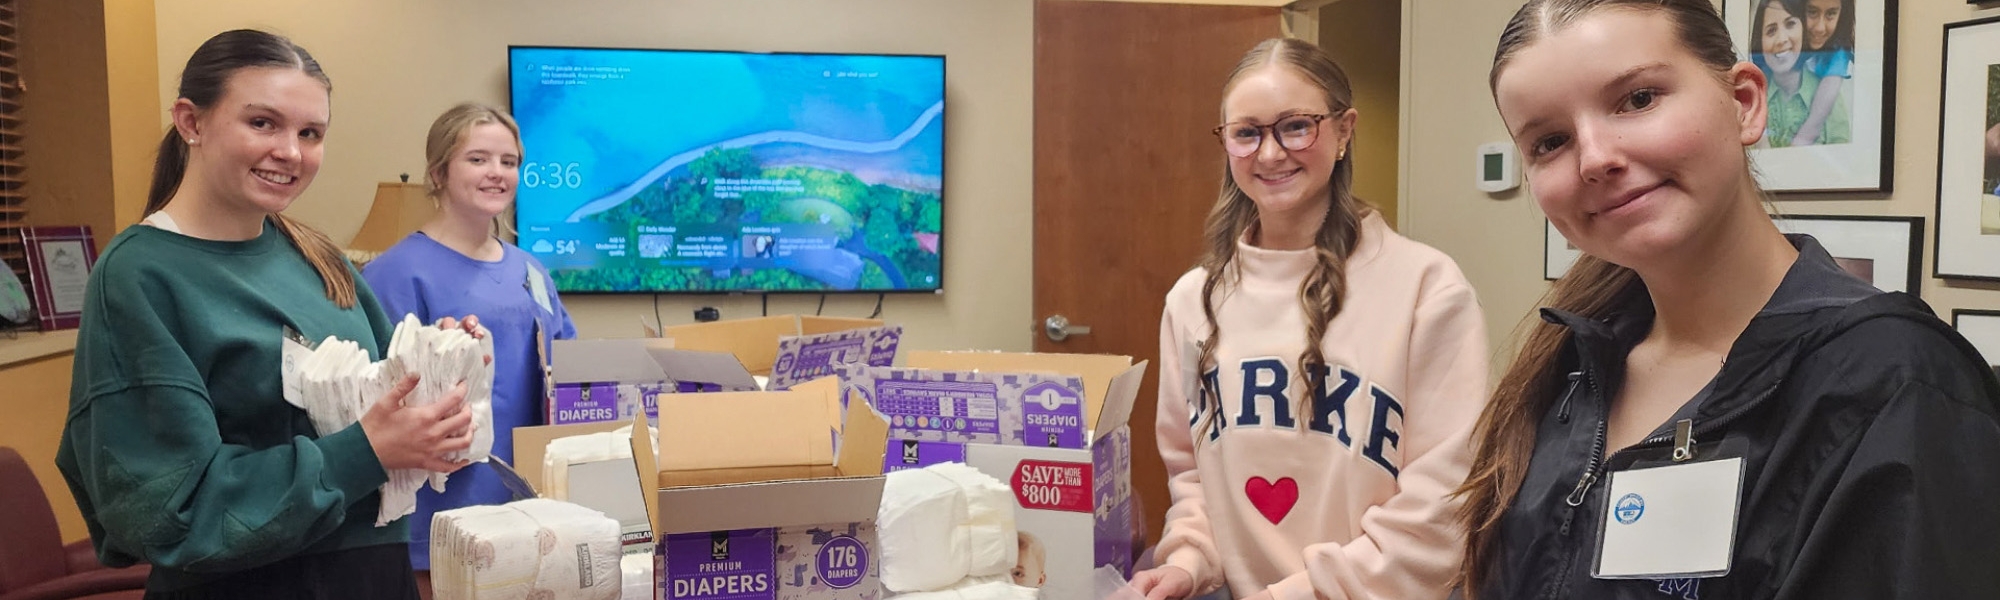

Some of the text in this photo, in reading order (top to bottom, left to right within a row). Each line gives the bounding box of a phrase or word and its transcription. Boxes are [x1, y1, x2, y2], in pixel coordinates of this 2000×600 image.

[523, 162, 582, 189] 6:36
[646, 394, 658, 407] 17
[560, 408, 613, 421] DIAPERS
[1027, 413, 1078, 427] DIAPERS
[1021, 465, 1082, 485] SAVE MORE
[1064, 476, 1082, 487] THAN
[1022, 483, 1061, 506] $800
[622, 531, 653, 542] KIRKLAN
[827, 545, 857, 569] 176
[700, 561, 742, 573] PREMIUM
[827, 568, 858, 579] DIAPERS
[674, 573, 768, 598] DIAPERS
